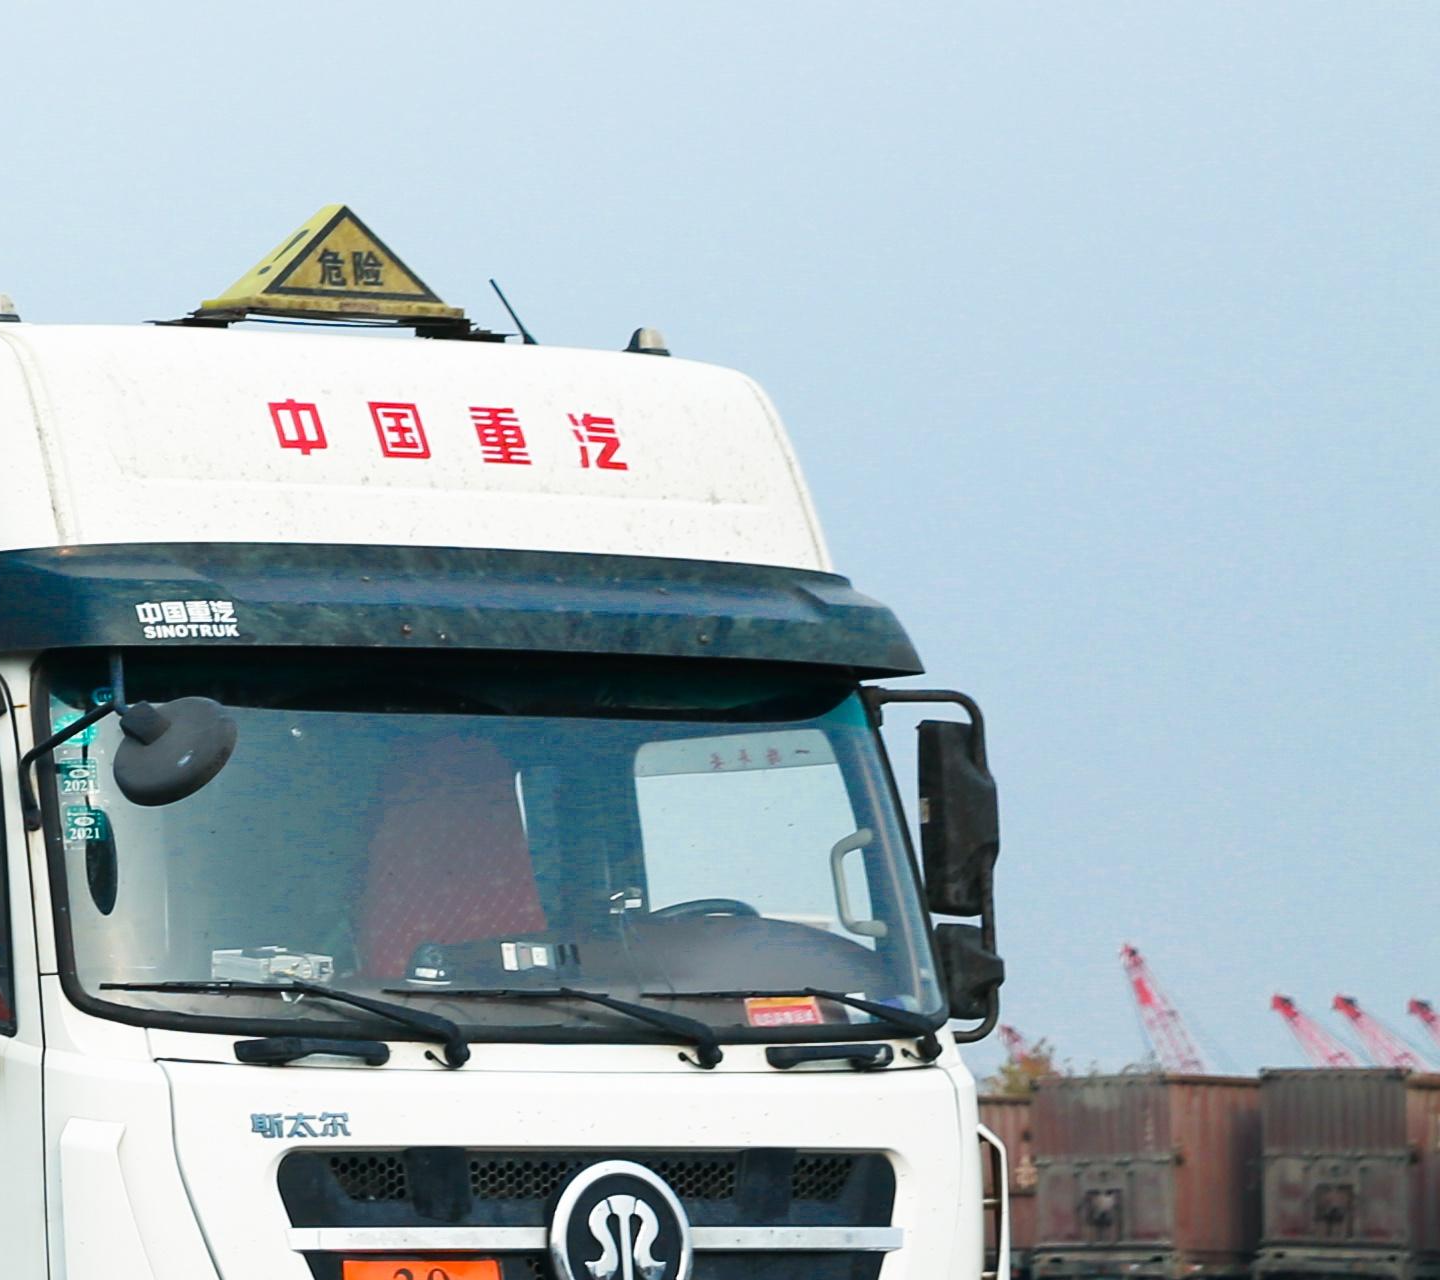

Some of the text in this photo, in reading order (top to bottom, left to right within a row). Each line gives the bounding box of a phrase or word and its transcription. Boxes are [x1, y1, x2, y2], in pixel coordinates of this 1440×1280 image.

[318, 249, 383, 286] 危险
[268, 398, 629, 471] 中国重汽
[135, 600, 238, 624] 中国重汽
[143, 624, 240, 639] SINOTRUK
[64, 780, 95, 793] 2021
[69, 827, 100, 840] 2021
[250, 1112, 352, 1139] 斯太尔
